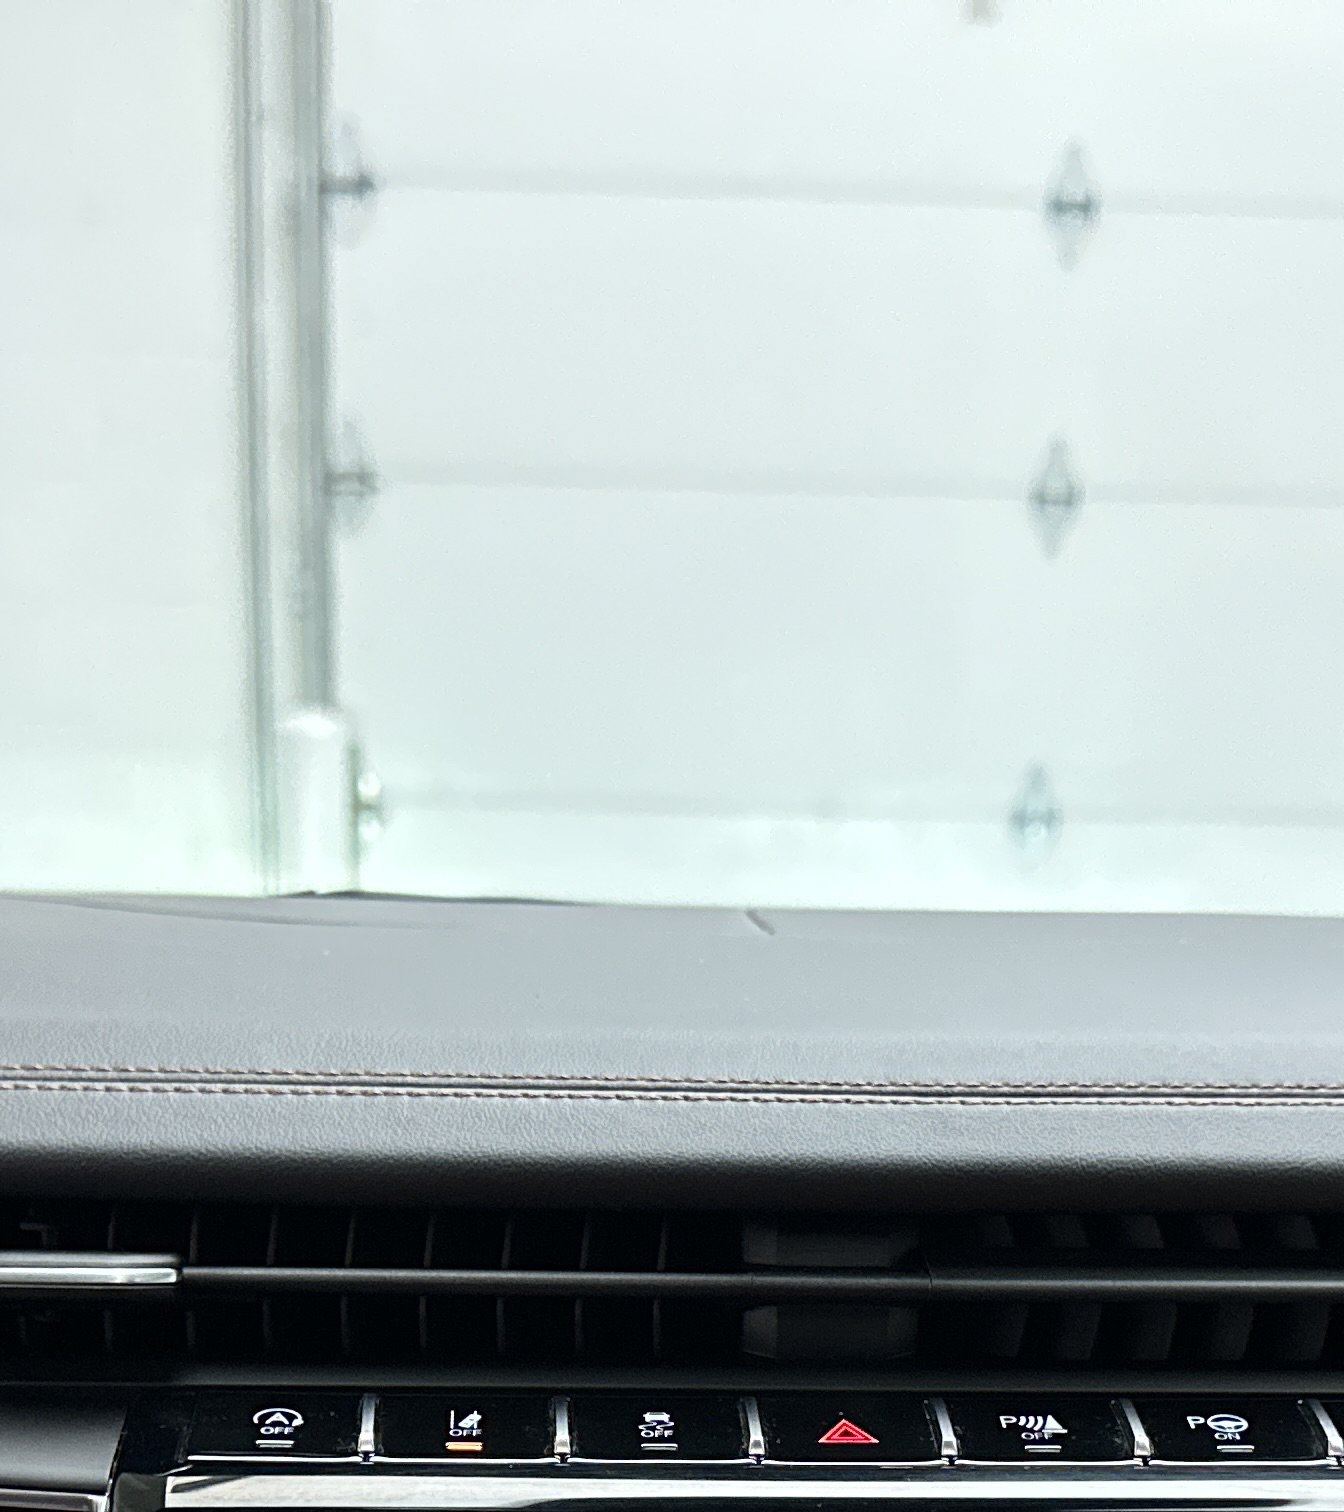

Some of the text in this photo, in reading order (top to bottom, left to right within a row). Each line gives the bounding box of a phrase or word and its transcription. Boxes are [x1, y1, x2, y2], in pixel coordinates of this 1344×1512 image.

[260, 1426, 294, 1435] OFF
[449, 1429, 482, 1437] OFF
[1214, 1432, 1241, 1440] ON
